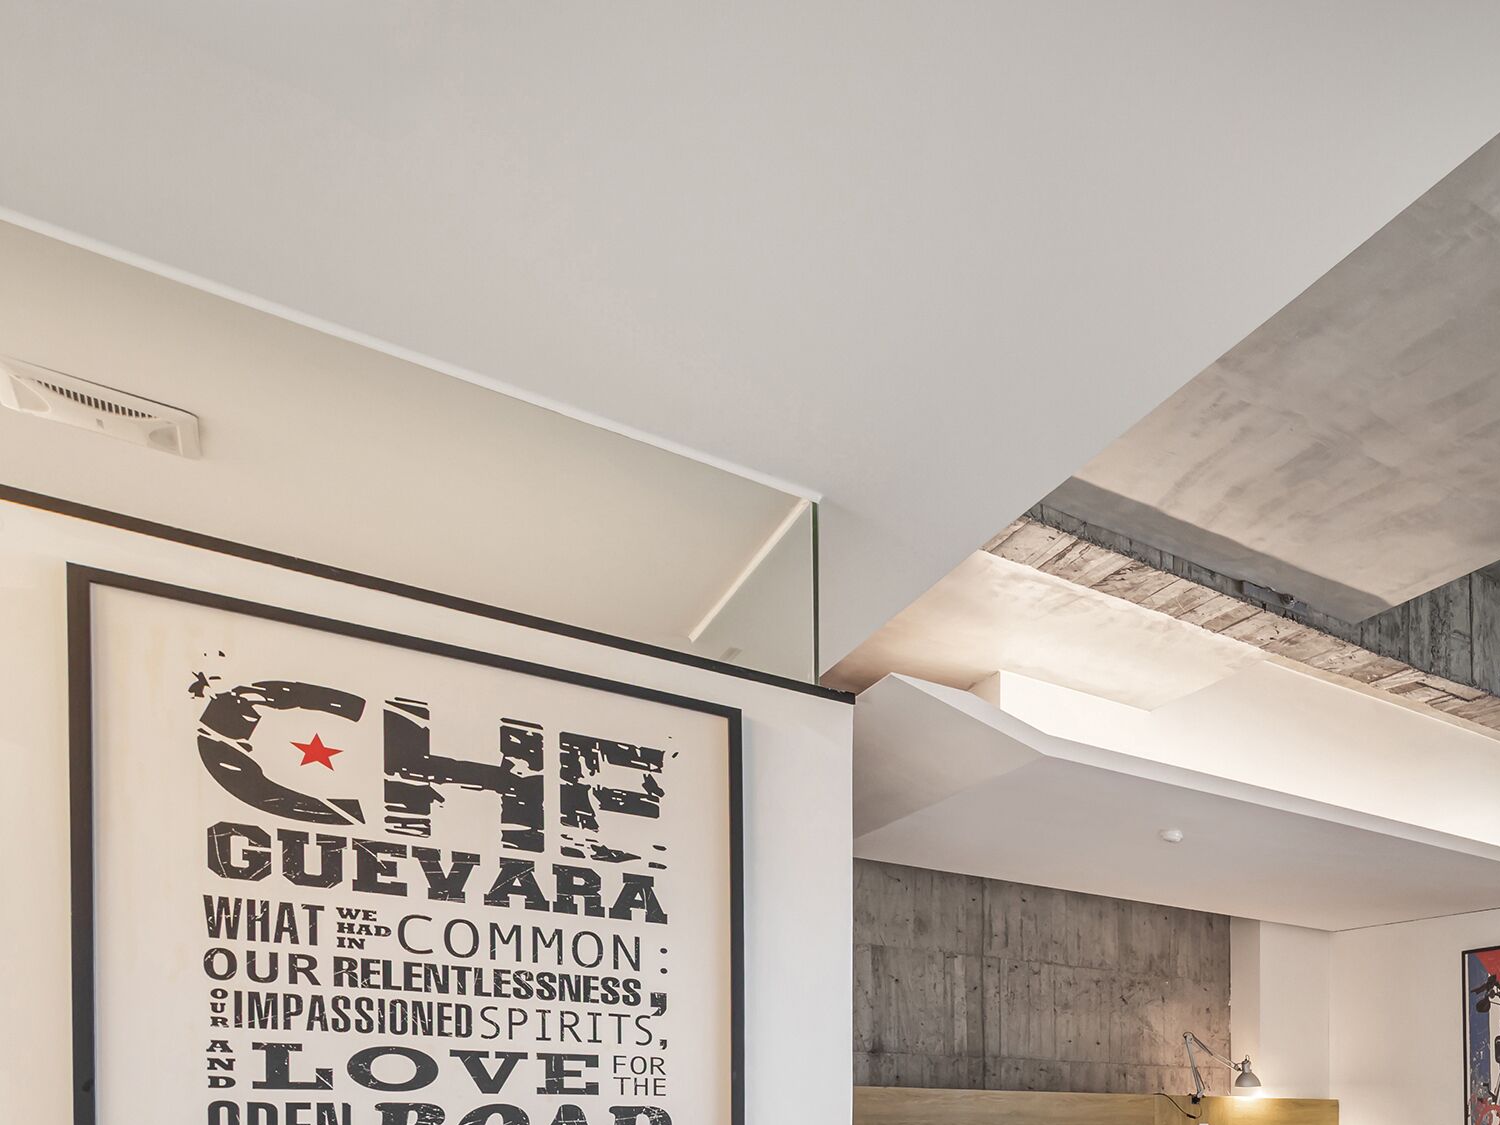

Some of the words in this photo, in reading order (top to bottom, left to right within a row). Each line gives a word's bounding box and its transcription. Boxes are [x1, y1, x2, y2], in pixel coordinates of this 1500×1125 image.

[197, 680, 667, 868] CHE
[206, 821, 668, 925] GUEVARA
[202, 894, 325, 946] WHAT
[336, 906, 377, 922] WE
[336, 921, 392, 938] HAD
[336, 936, 366, 950] IN
[203, 947, 322, 986] OUR
[209, 988, 230, 1028] OUR
[233, 990, 473, 1039] IMPASSIONED
[480, 1005, 668, 1050] SPIRITS,
[206, 1039, 237, 1089] AND
[251, 1041, 600, 1096] LOVE
[613, 1055, 666, 1076] FOR
[613, 1076, 667, 1097] THE
